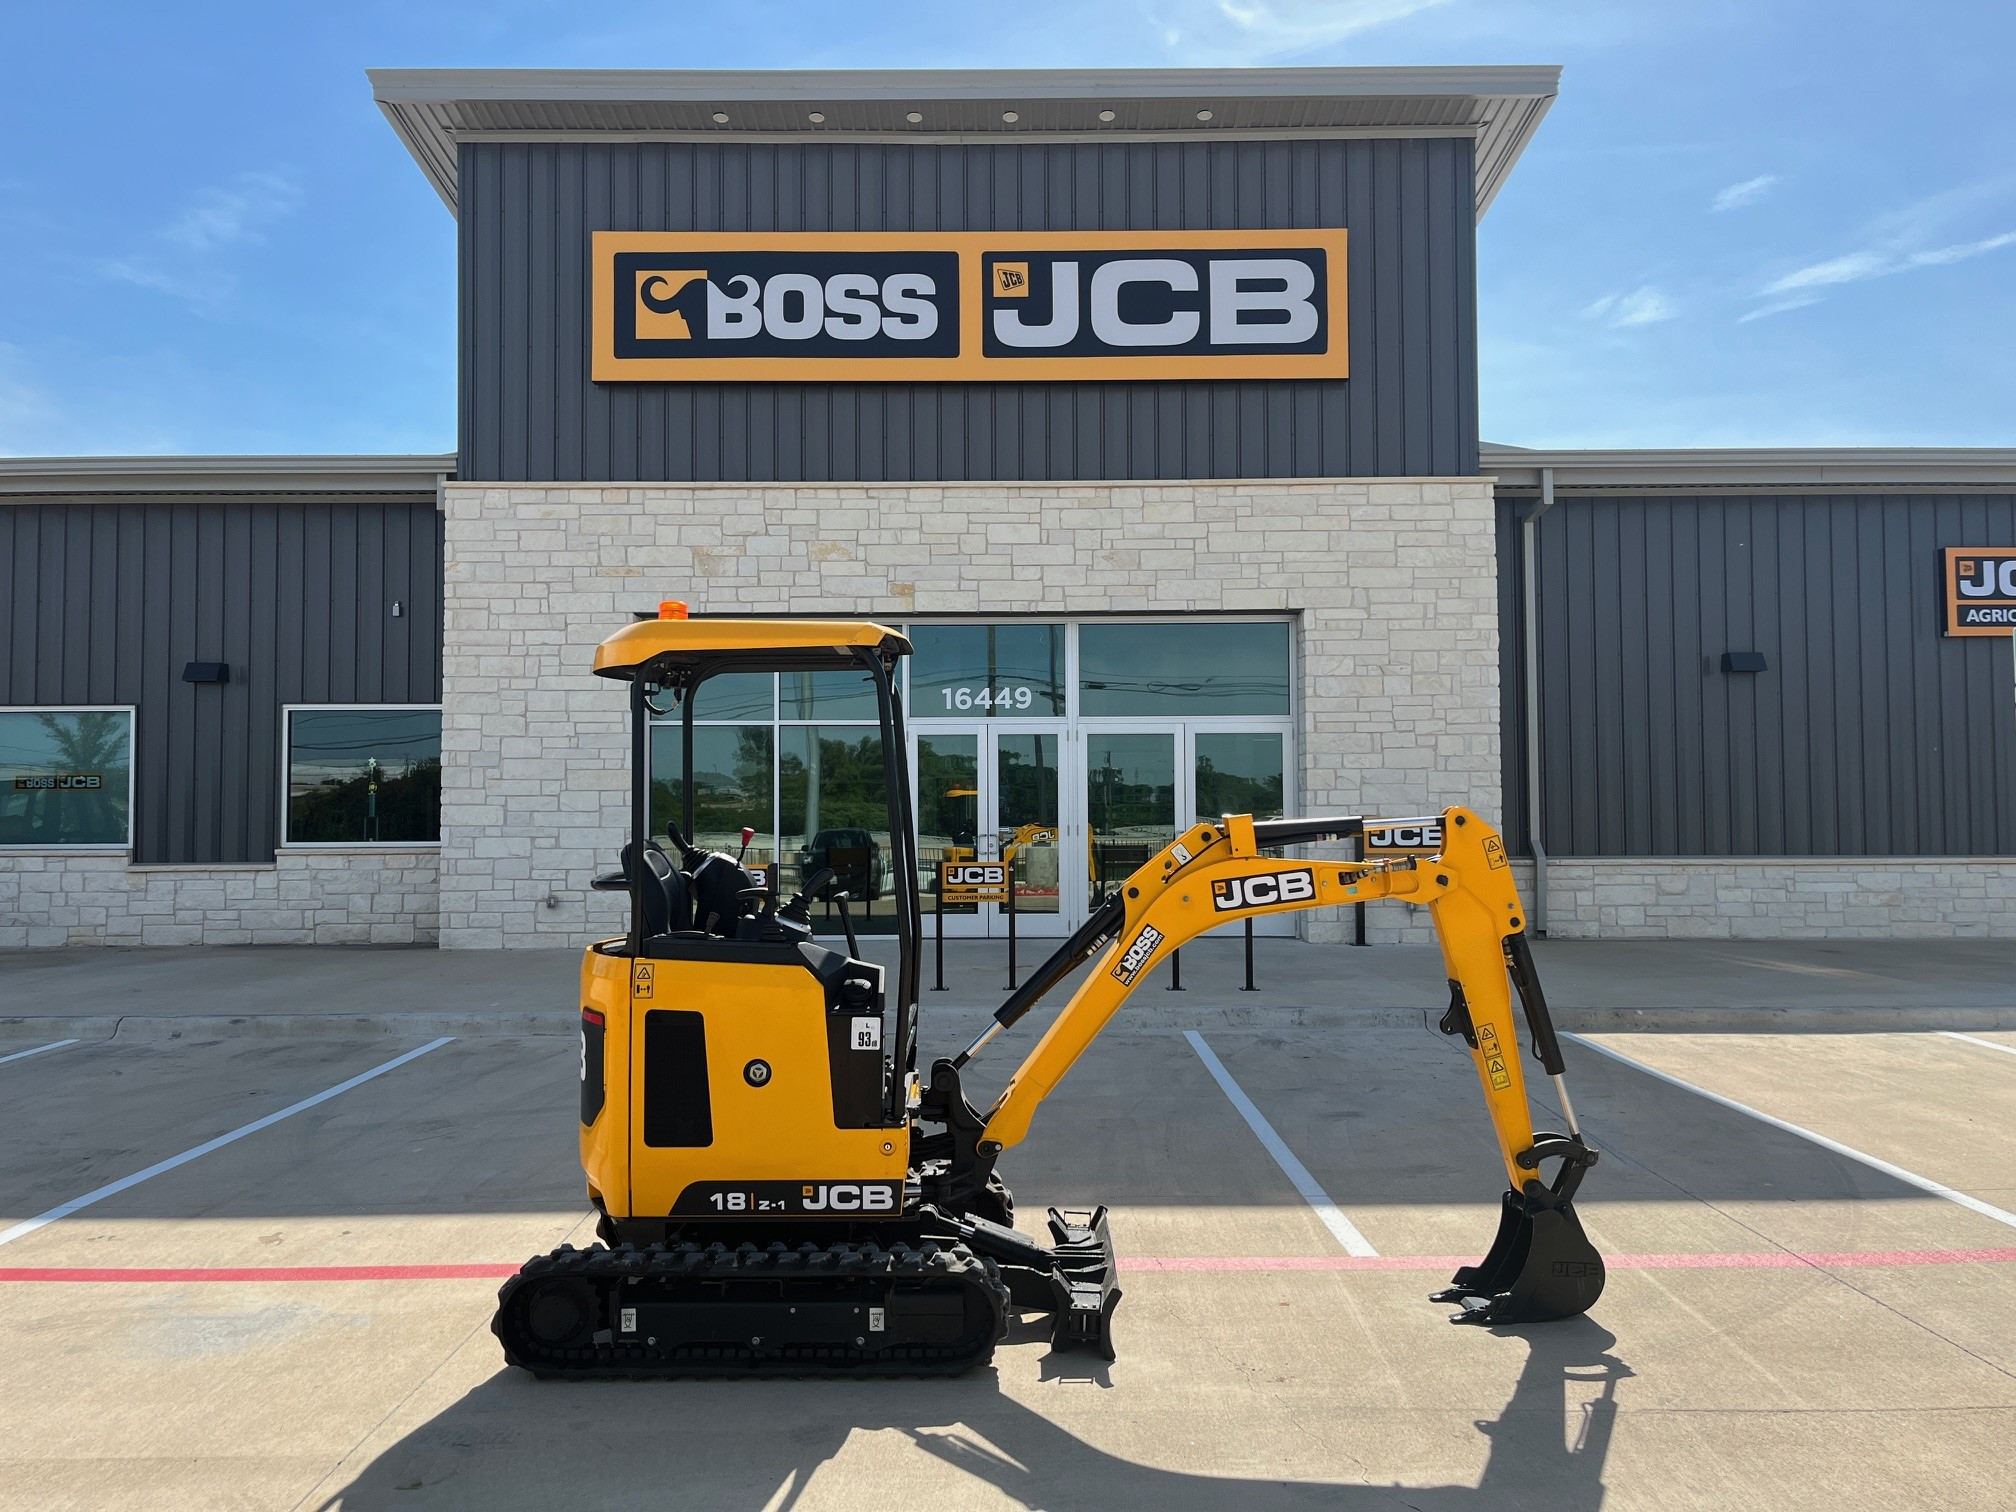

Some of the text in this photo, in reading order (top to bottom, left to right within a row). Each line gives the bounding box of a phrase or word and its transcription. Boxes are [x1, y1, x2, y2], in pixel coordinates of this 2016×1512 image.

[1002, 271, 1023, 288] JCB
[707, 273, 938, 340] BOSS
[993, 259, 1319, 348] JCB
[941, 687, 1032, 710] 16449
[26, 776, 101, 788] BOSS JCB
[948, 867, 1004, 884] JCB
[1215, 871, 1313, 909] JCB
[1121, 926, 1159, 971] BOSS
[1124, 934, 1164, 985] www.bossjcb.com
[858, 1031, 872, 1047] 93
[709, 1192, 746, 1211] 18
[802, 1185, 894, 1210] JCB
